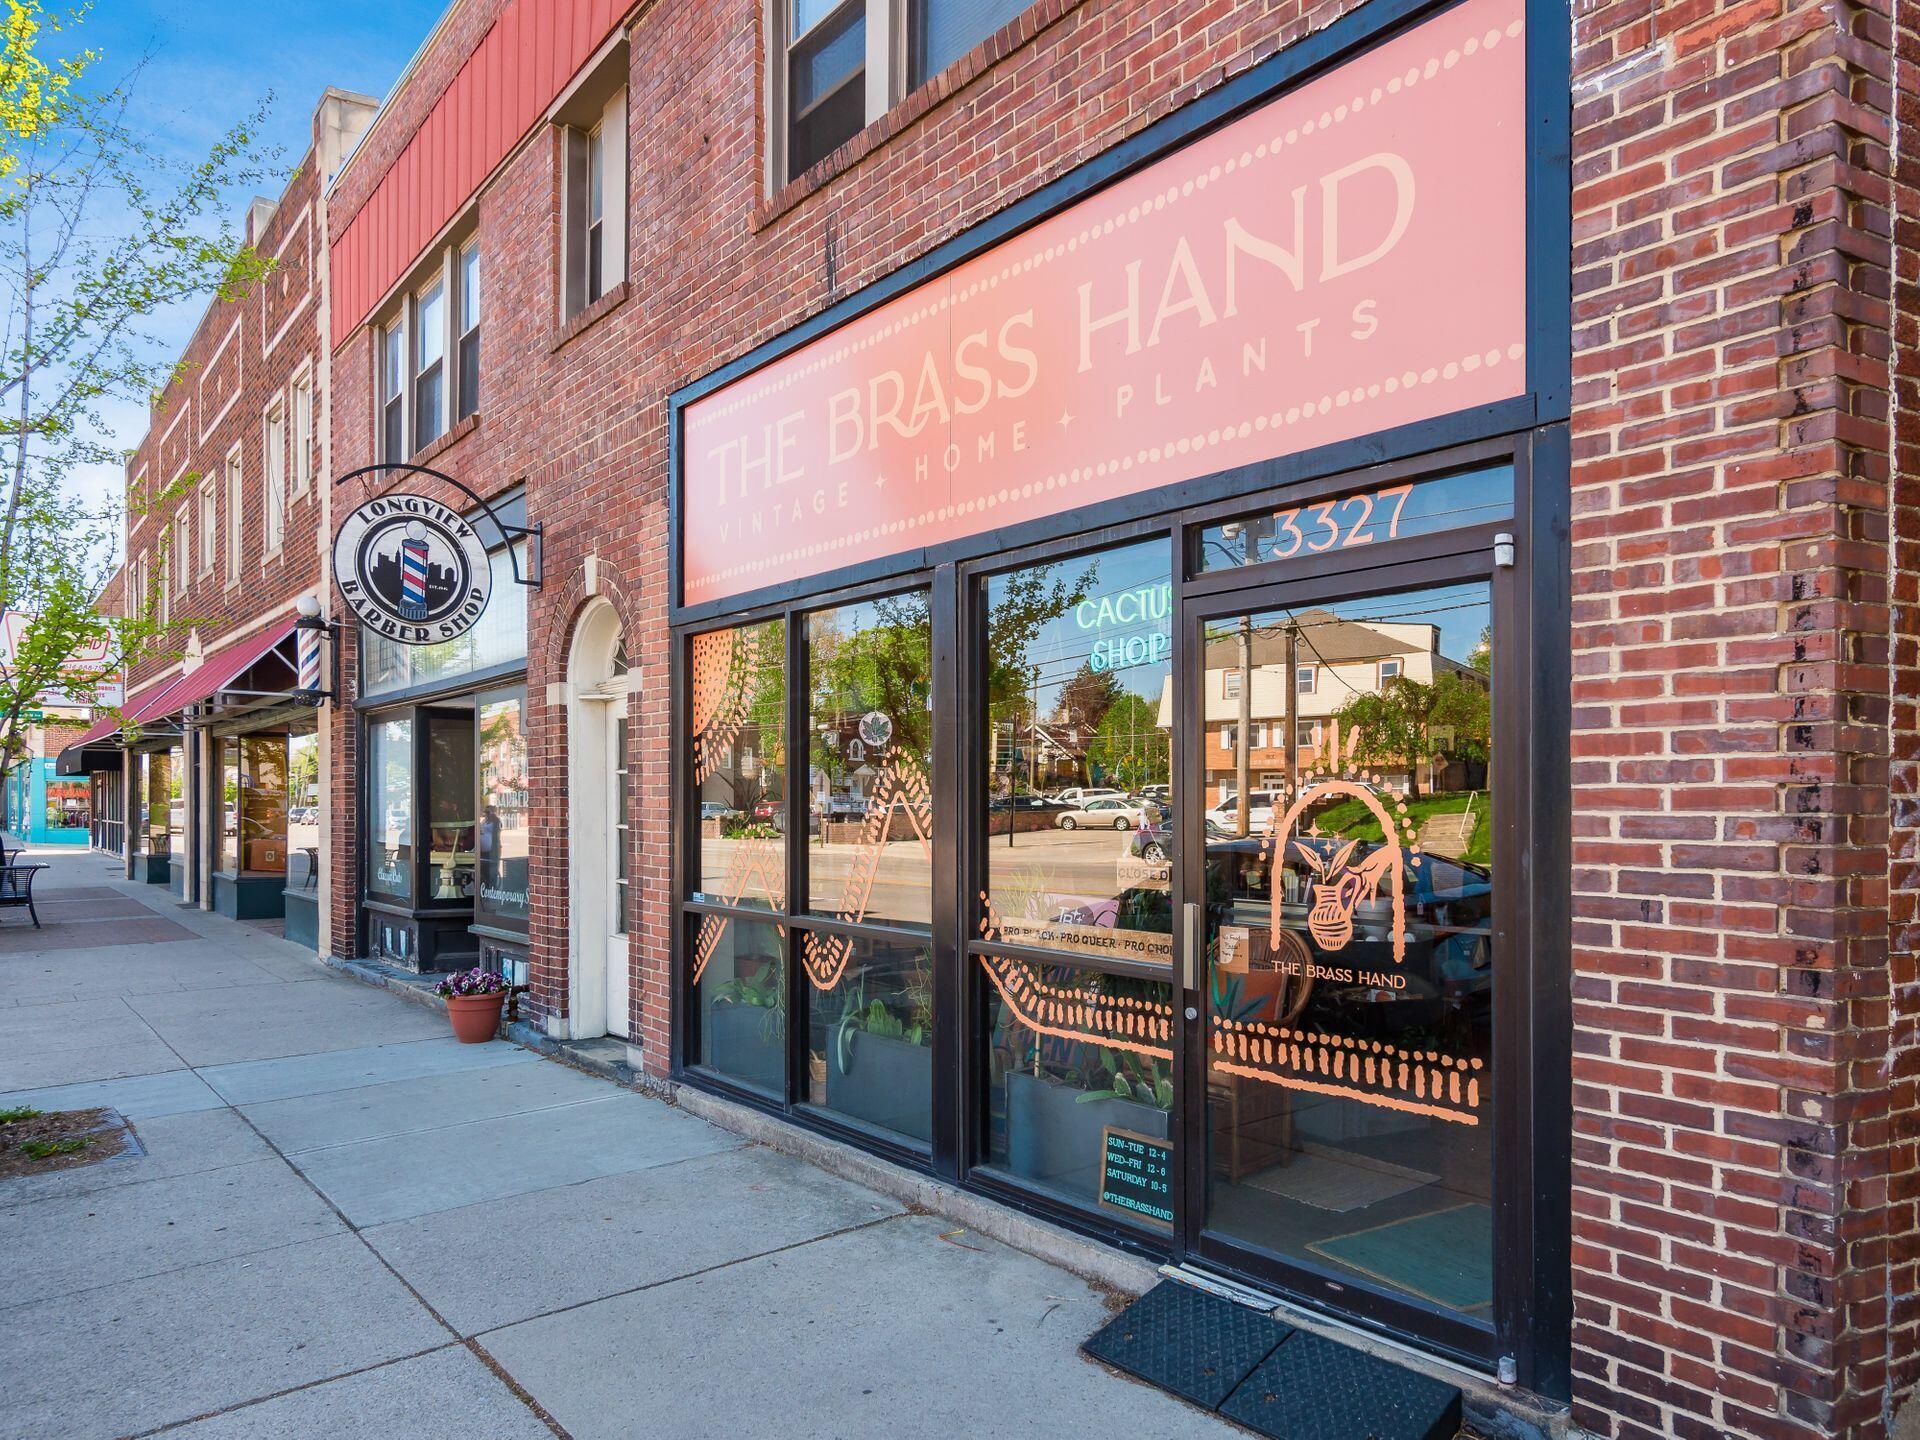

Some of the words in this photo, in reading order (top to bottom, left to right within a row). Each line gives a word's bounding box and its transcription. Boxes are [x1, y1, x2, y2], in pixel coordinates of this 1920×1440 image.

[707, 410, 805, 507] THE
[828, 308, 1038, 466] BRASS
[1077, 152, 1416, 373] HAND
[719, 481, 849, 544] VINTAGE
[915, 420, 1027, 483] HOME
[1117, 298, 1379, 419] PLANTS
[356, 497, 474, 539] LONGVIEW
[1273, 484, 1414, 558] 3327
[341, 581, 431, 642] BARBER
[439, 587, 485, 638] SHOP
[1090, 632, 1166, 673] SHOP
[1004, 926, 1020, 935] PRO
[1060, 932, 1080, 944] PRO
[1082, 935, 1116, 949] QUEER
[1124, 940, 1145, 951] PRO
[1271, 960, 1300, 975] THE
[1306, 964, 1353, 983] BRASS
[1358, 970, 1406, 989] HAND
[1107, 1151, 1142, 1170] WED-FRI
[1108, 1137, 1144, 1155] SUN-TUE
[1107, 1168, 1148, 1187] SATURDAY
[1103, 1191, 1174, 1221] @THEBRASSHAND
